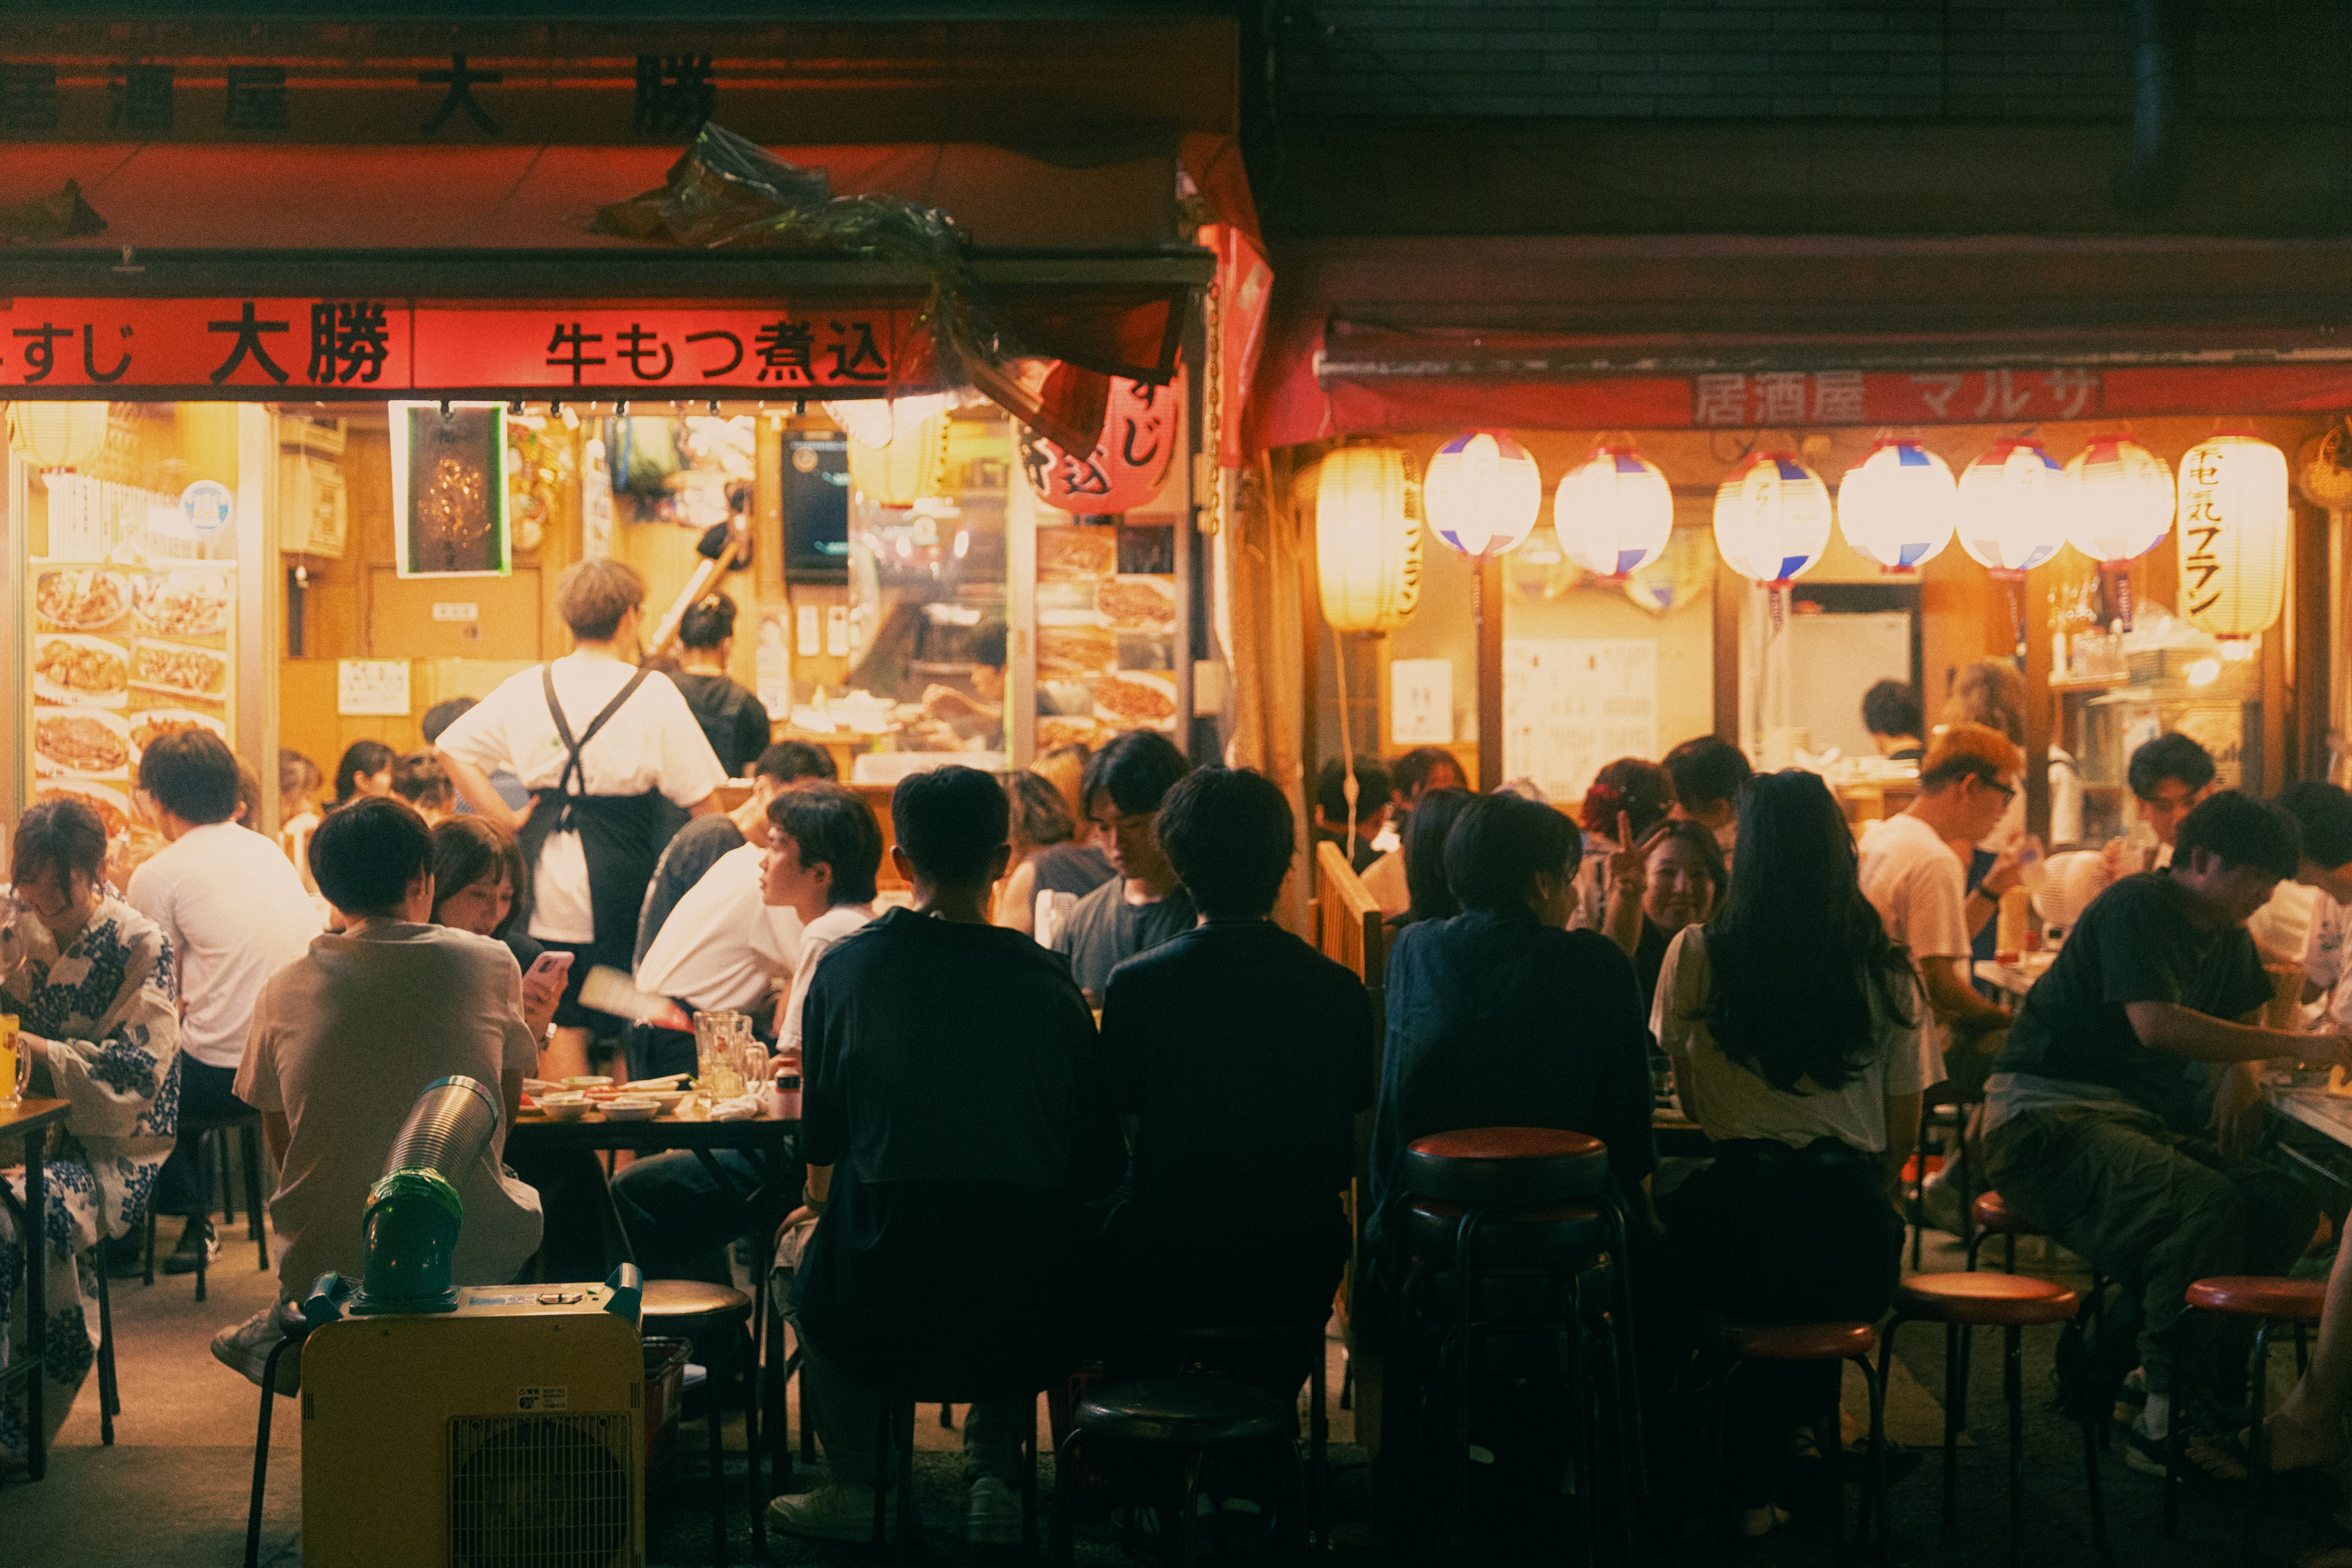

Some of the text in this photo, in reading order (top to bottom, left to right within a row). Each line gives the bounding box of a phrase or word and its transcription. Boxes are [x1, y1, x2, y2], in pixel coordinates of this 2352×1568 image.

[0, 301, 389, 385] すじ 大勝
[546, 322, 888, 385] 牛もつ煮込
[1695, 370, 1867, 424] 居酒屋
